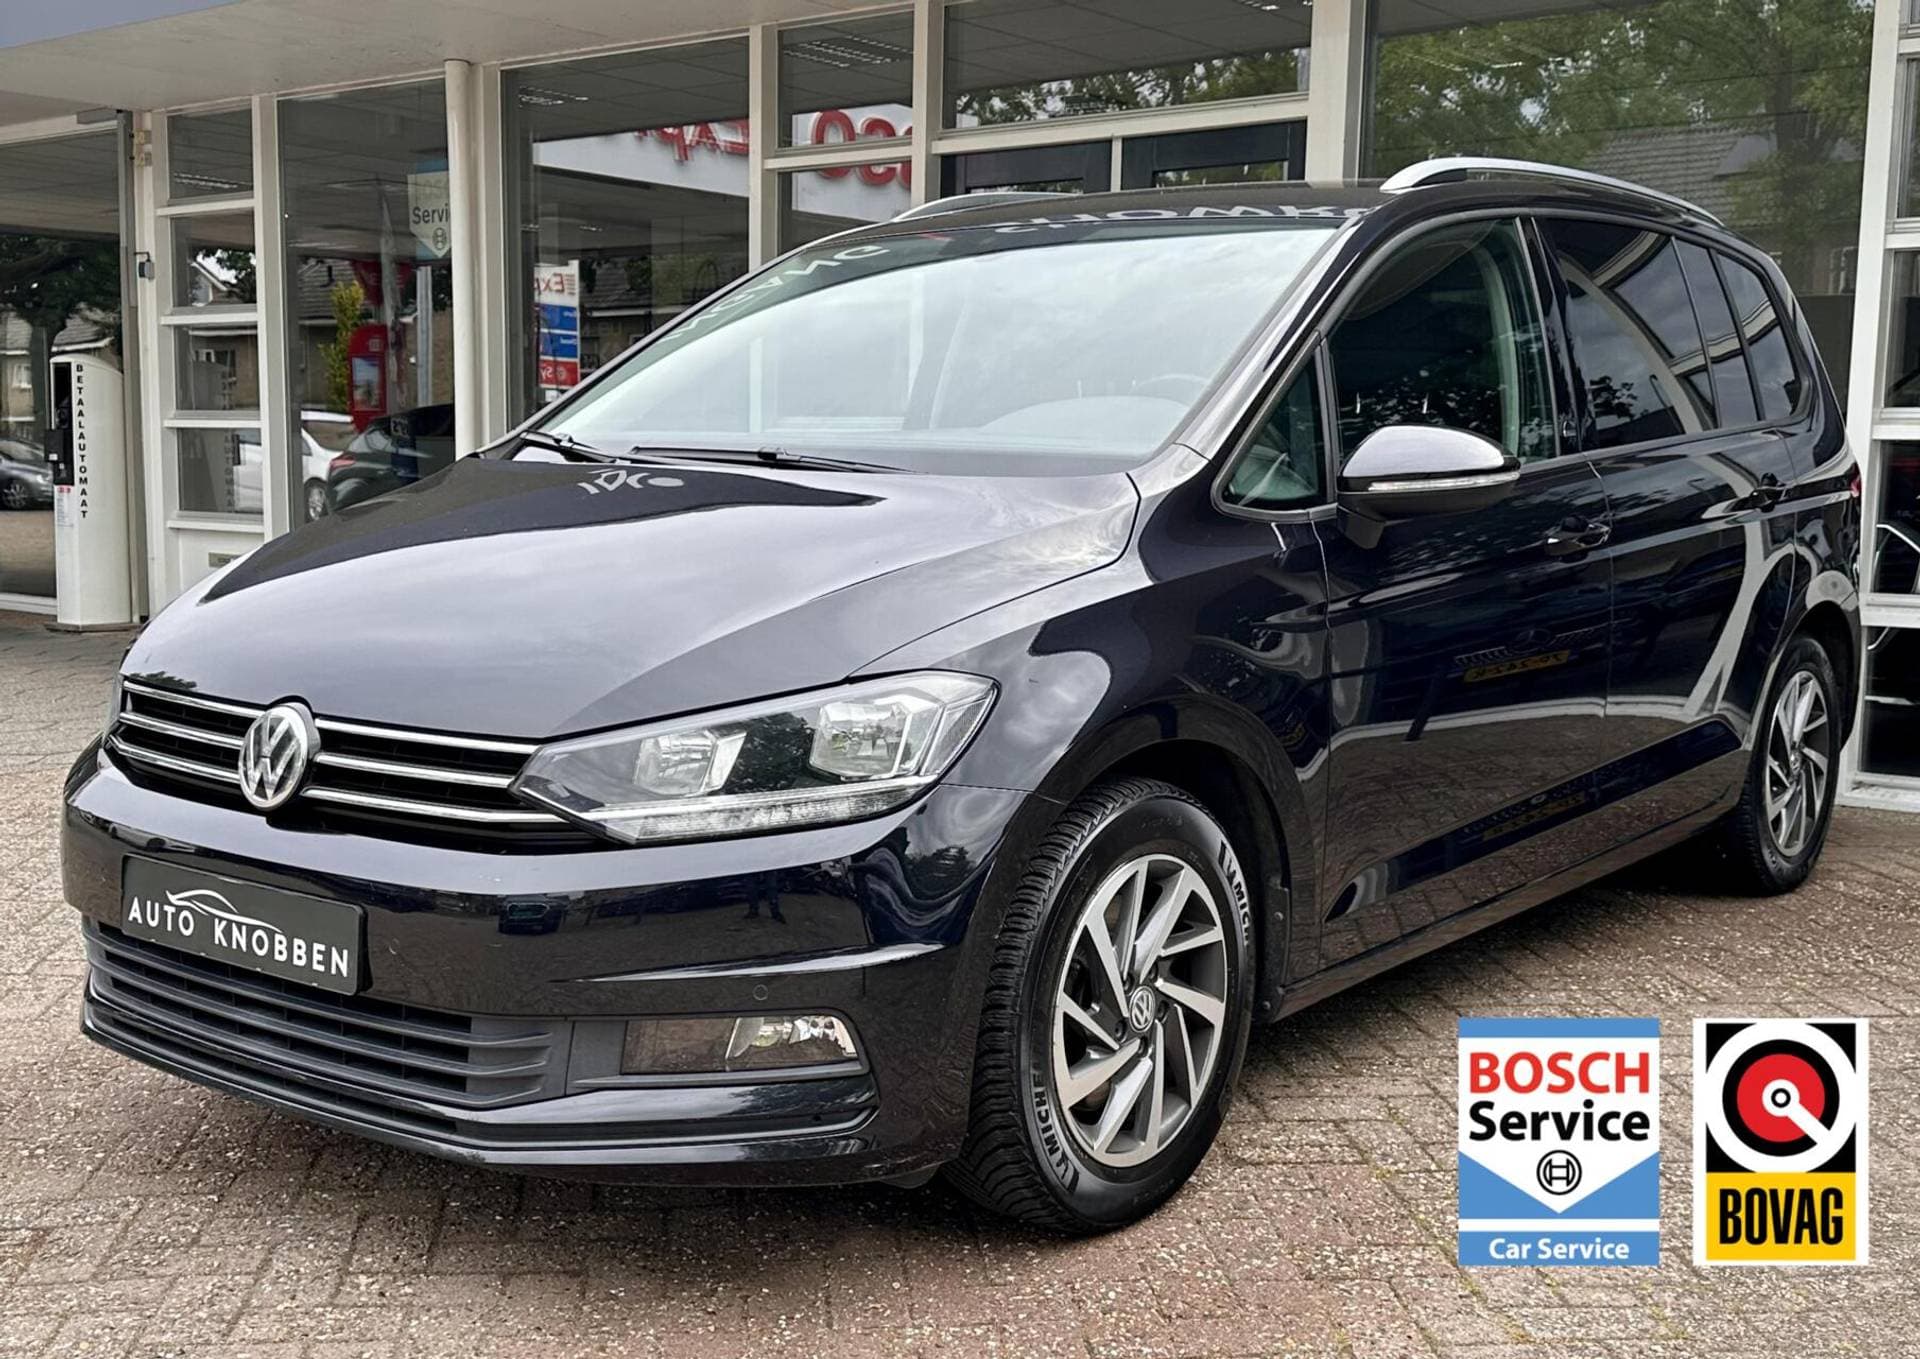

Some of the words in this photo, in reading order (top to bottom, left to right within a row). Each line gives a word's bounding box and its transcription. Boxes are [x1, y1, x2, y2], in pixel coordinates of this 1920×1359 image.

[411, 203, 450, 226] Servi
[76, 364, 88, 518] BETAALAUTOMAAT
[128, 896, 195, 936] AUTO
[214, 917, 349, 978] KNOBBEN
